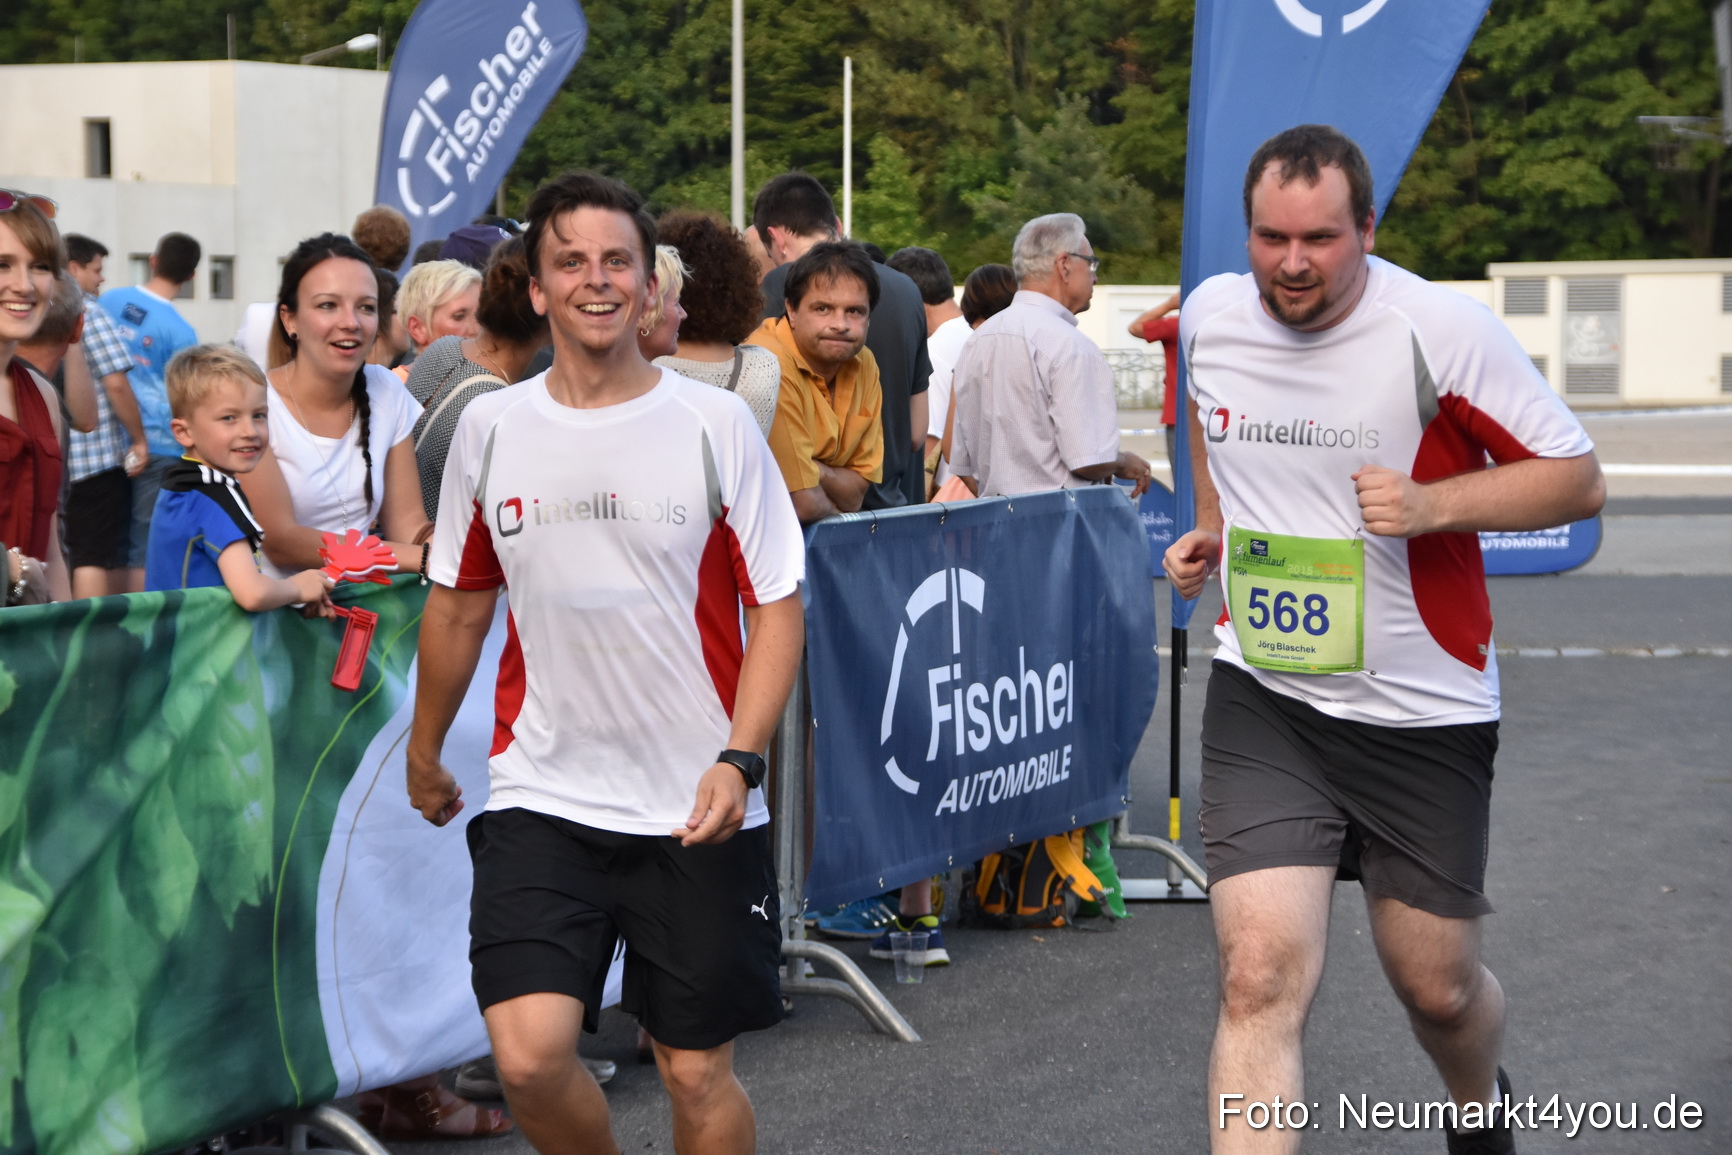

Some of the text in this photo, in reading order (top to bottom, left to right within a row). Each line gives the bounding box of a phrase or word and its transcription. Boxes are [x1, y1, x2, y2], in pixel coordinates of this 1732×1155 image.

[425, 0, 542, 185] Fischer
[465, 36, 552, 183] AUTOMOBILE
[1238, 414, 1380, 449] intellitools
[533, 492, 686, 525] intellitools
[1480, 536, 1569, 551] UTOMOBILE
[1248, 586, 1330, 636] 568
[1258, 640, 1317, 654] Jörg Blaschek
[935, 744, 1072, 816] AUTOMOBILE
